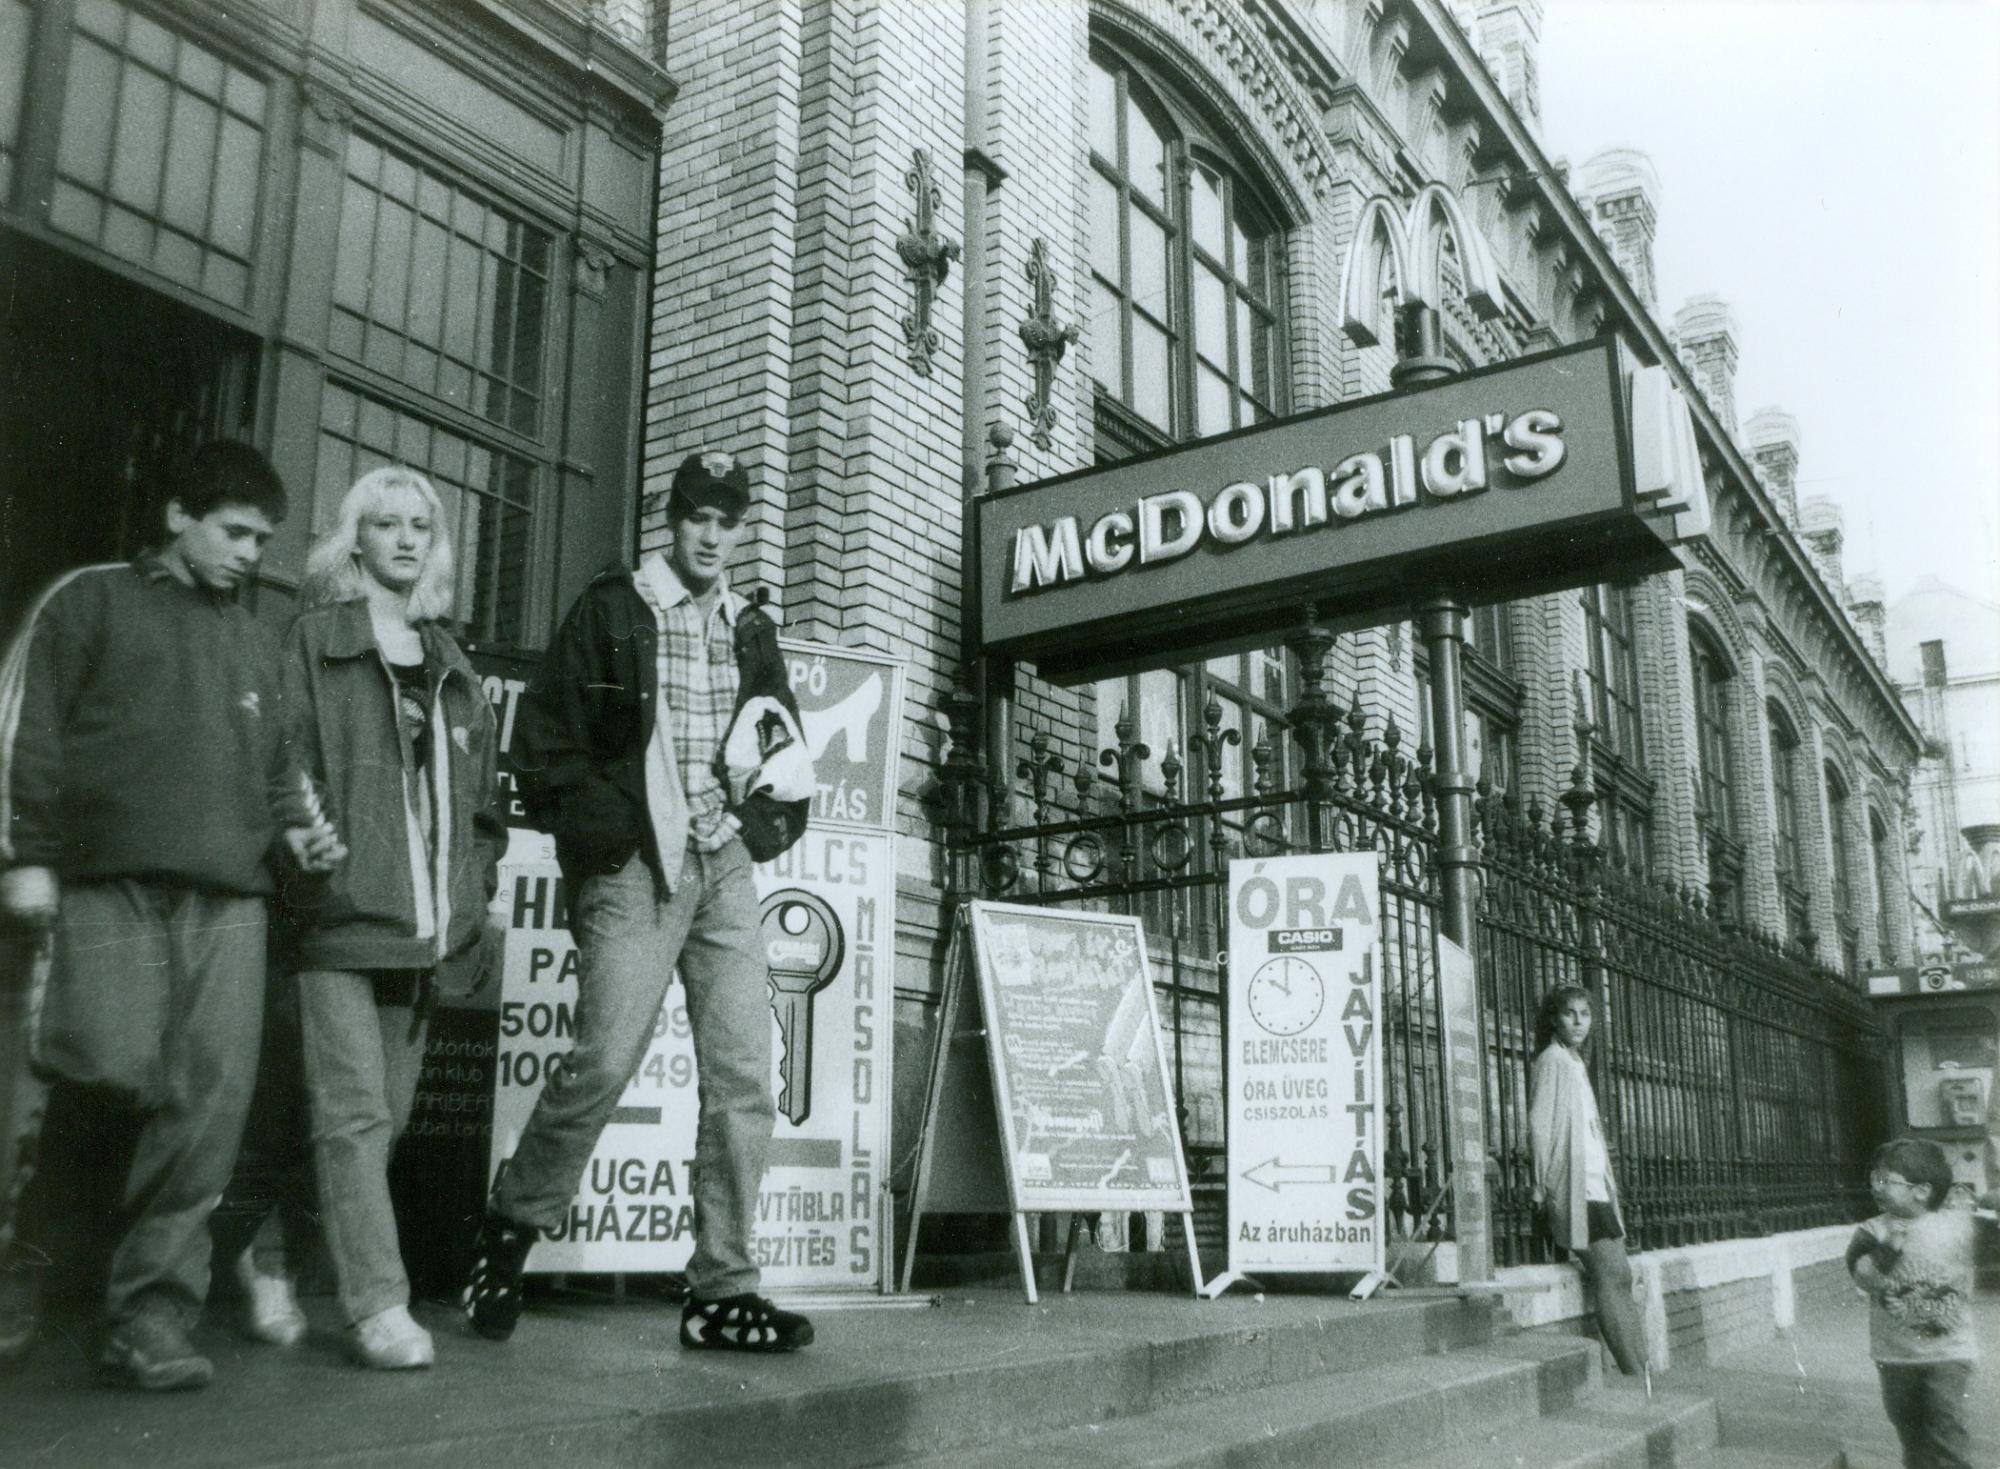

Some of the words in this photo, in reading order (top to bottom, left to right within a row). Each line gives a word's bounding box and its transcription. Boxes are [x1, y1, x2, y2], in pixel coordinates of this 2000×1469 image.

[1010, 408, 1566, 594] McDonald's
[786, 656, 828, 696] PŐ
[816, 778, 868, 821] TÁS
[1236, 862, 1373, 930] ÓRA
[1278, 930, 1334, 945] CASIO
[1242, 1037, 1328, 1065] ELEMCSERE
[1243, 1074, 1278, 1101] ÓRA
[1282, 1073, 1329, 1100] ÜVEG
[1340, 952, 1376, 1221] JAVÍTÁS
[758, 1185, 845, 1222] VTÁBLA
[1239, 1221, 1262, 1243] Az
[1267, 1219, 1371, 1243] áruházban
